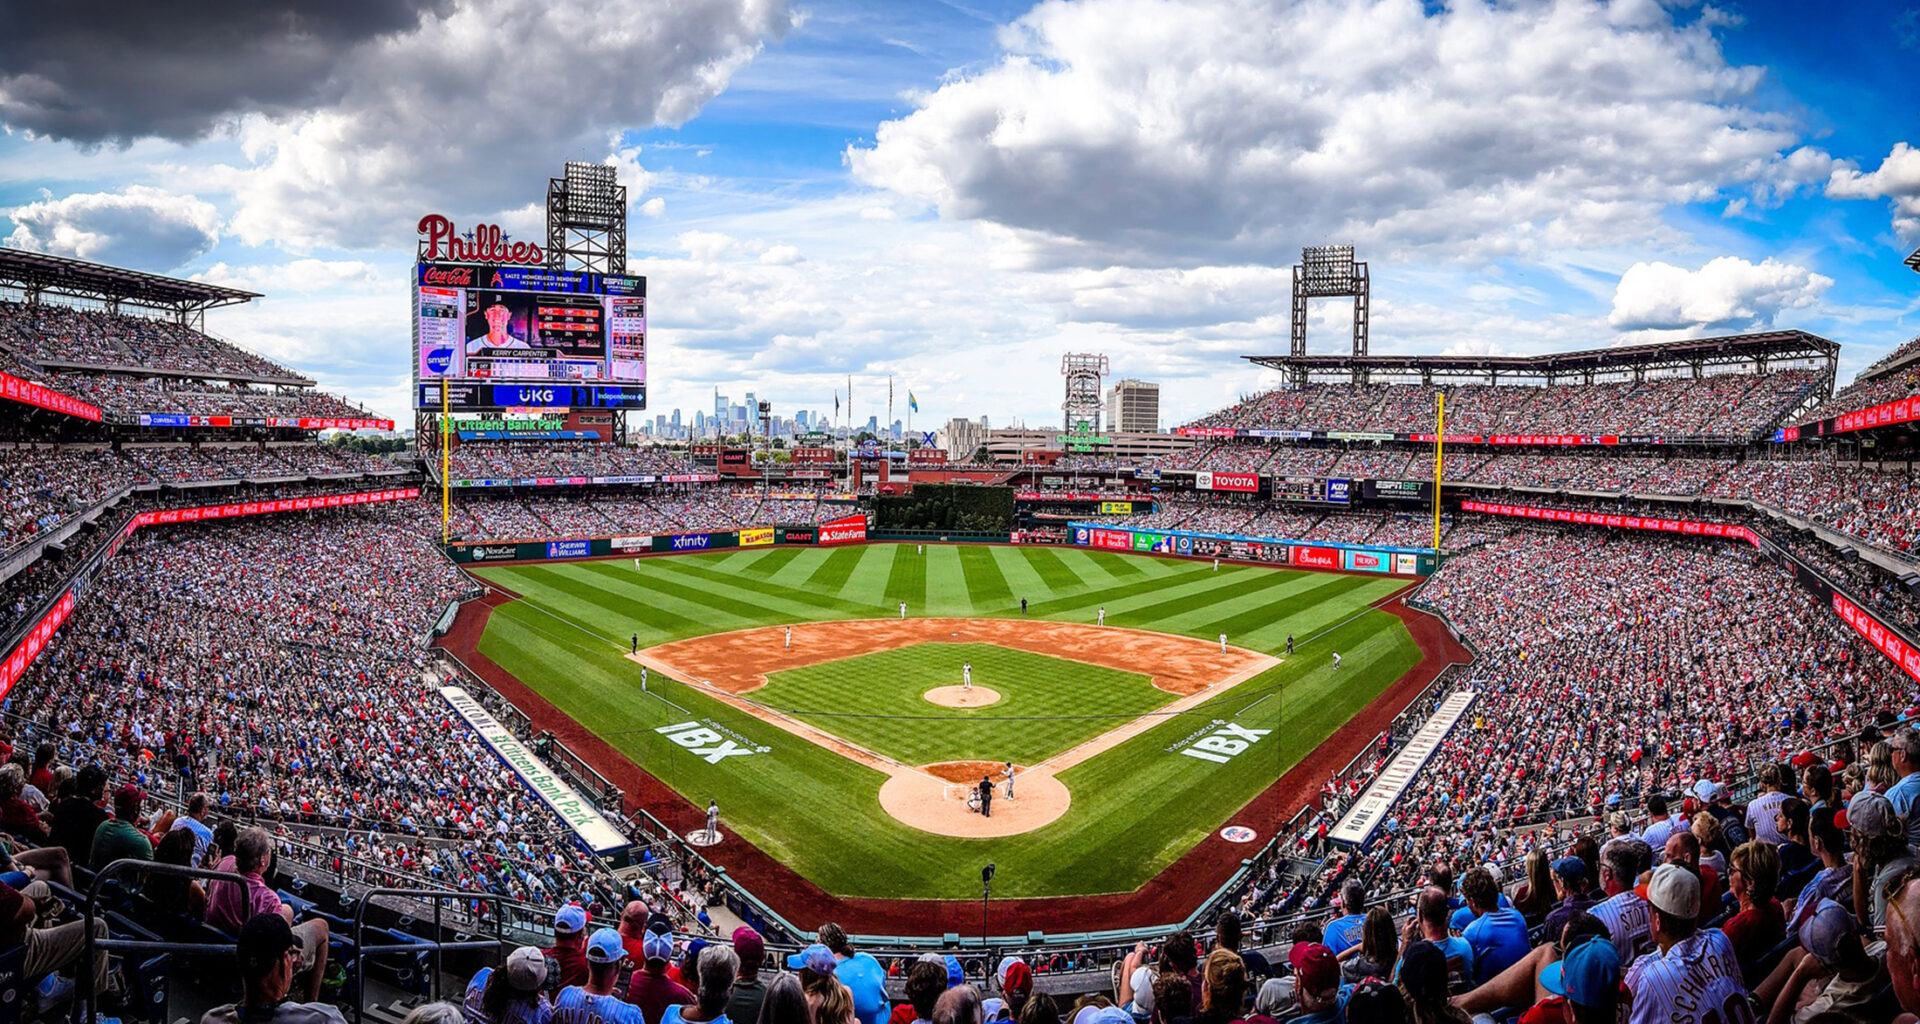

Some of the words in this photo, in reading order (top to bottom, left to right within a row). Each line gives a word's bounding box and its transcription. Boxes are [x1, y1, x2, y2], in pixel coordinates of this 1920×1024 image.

[418, 214, 543, 264] Phillies
[424, 267, 473, 285] Coca-Cola
[427, 356, 450, 364] smart
[512, 350, 547, 358] CARPENTER
[458, 418, 503, 430] Citizens
[508, 420, 536, 430] Bank
[538, 420, 563, 431] Park
[1215, 476, 1255, 487] TOYOTA
[1376, 481, 1402, 489] ESPN
[1403, 481, 1424, 491] BET
[674, 535, 708, 548] xfinity
[1107, 533, 1127, 541] Temple
[559, 542, 587, 550] SHERWIN
[1107, 540, 1126, 548] Health
[486, 547, 516, 556] NovaCare
[451, 695, 497, 731] WELCOME
[654, 720, 755, 765] IBX
[1180, 722, 1273, 764] IBX
[1371, 729, 1441, 800] PHILADELPHIA
[499, 742, 541, 778] Citizens
[533, 773, 568, 803] Bank
[558, 800, 593, 827] Park
[1345, 809, 1374, 832] HOME
[1620, 904, 1650, 932] STOT
